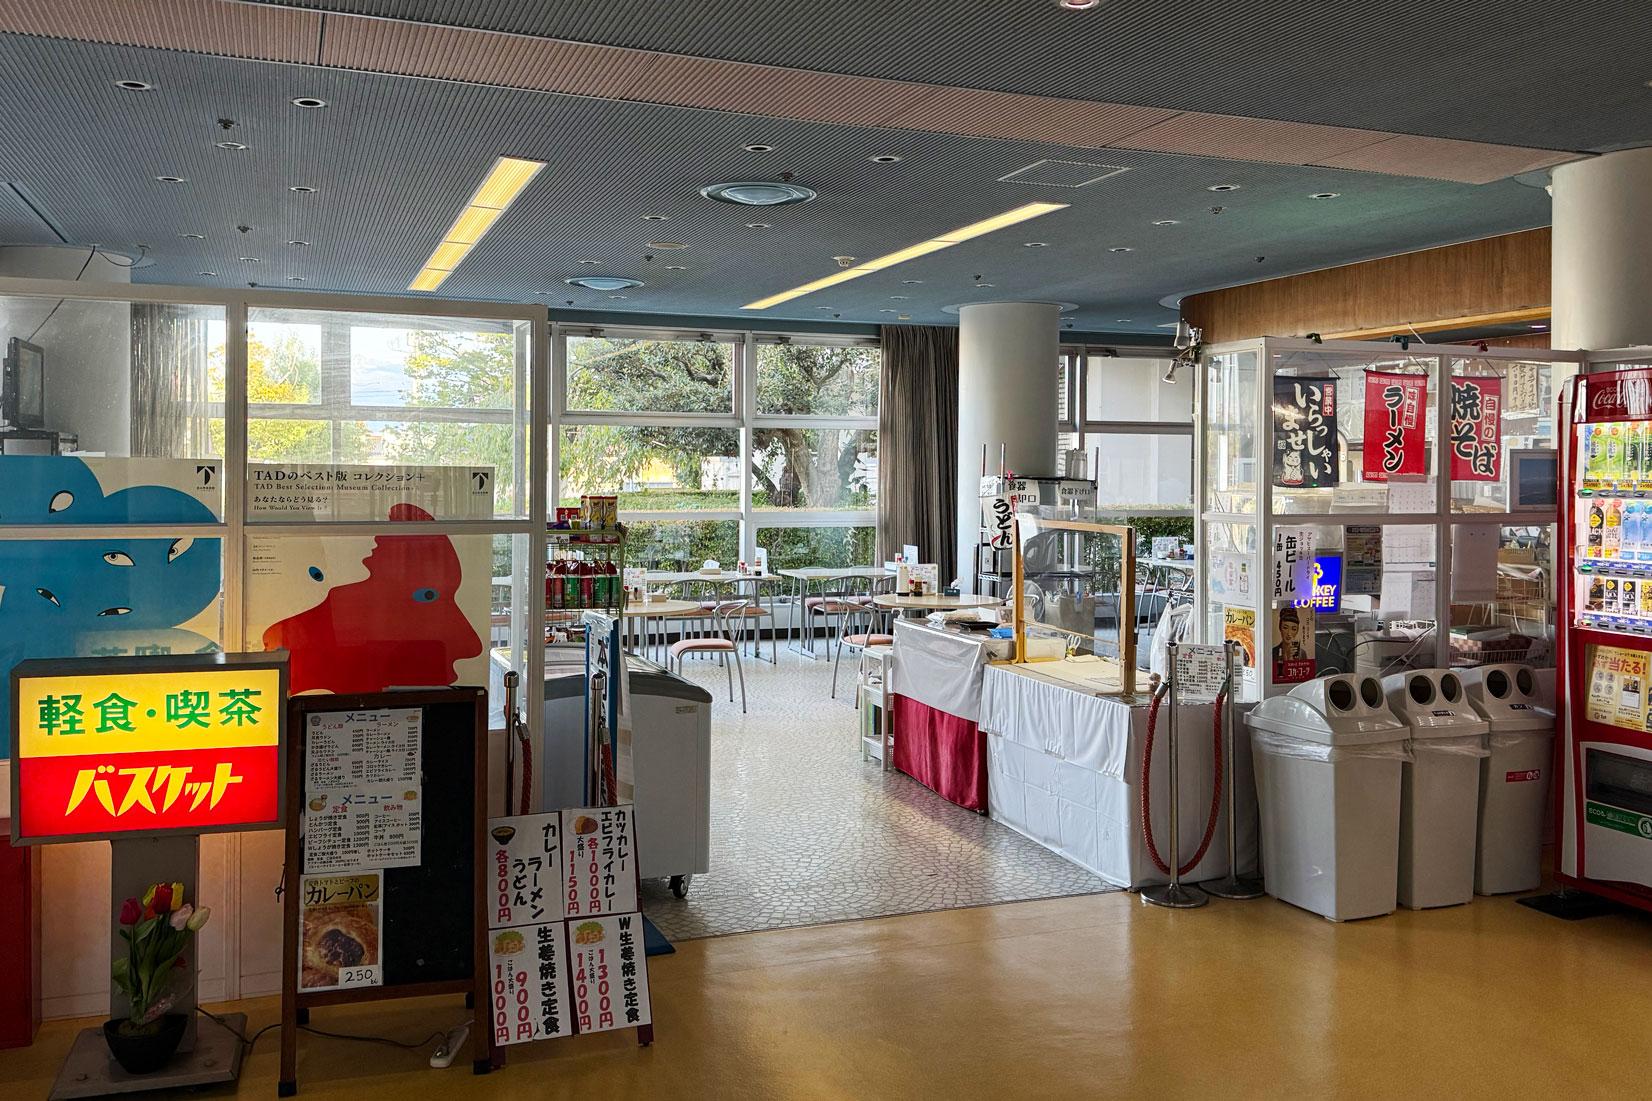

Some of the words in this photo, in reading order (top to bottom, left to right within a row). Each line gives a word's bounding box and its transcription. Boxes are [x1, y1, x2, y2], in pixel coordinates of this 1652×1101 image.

[1383, 386, 1404, 472] ラーメン
[1451, 382, 1498, 476] 焼そば
[254, 470, 348, 482] TADのベスト版
[1008, 480, 1026, 490] 食器
[993, 498, 1012, 546] うどん
[1285, 536, 1297, 592] 缶ビール
[1226, 612, 1255, 626] カレーパン
[1294, 596, 1336, 608] COFFEE
[38, 688, 262, 736] 軽食・喫茶
[345, 713, 390, 723] メニュー
[65, 763, 243, 817] バスケット
[342, 794, 392, 805] メニュー
[542, 823, 557, 867] カレー
[601, 811, 615, 911] エビフライカレー
[615, 810, 628, 872] カツカレー
[305, 882, 378, 904] カレーパン
[496, 850, 511, 922] 各800円
[513, 859, 527, 906] うどん
[528, 857, 544, 919] ラーメン
[568, 850, 579, 914] 1150円
[588, 838, 601, 913] 各1000円
[345, 970, 372, 983] 250
[537, 926, 560, 1035] 生姜焼き定食
[576, 953, 592, 1031] 1400円
[598, 949, 613, 1028] 1300円
[619, 917, 640, 1023] W生姜焼き定食
[495, 964, 510, 1043] 1000円
[516, 971, 532, 1040] 900円
